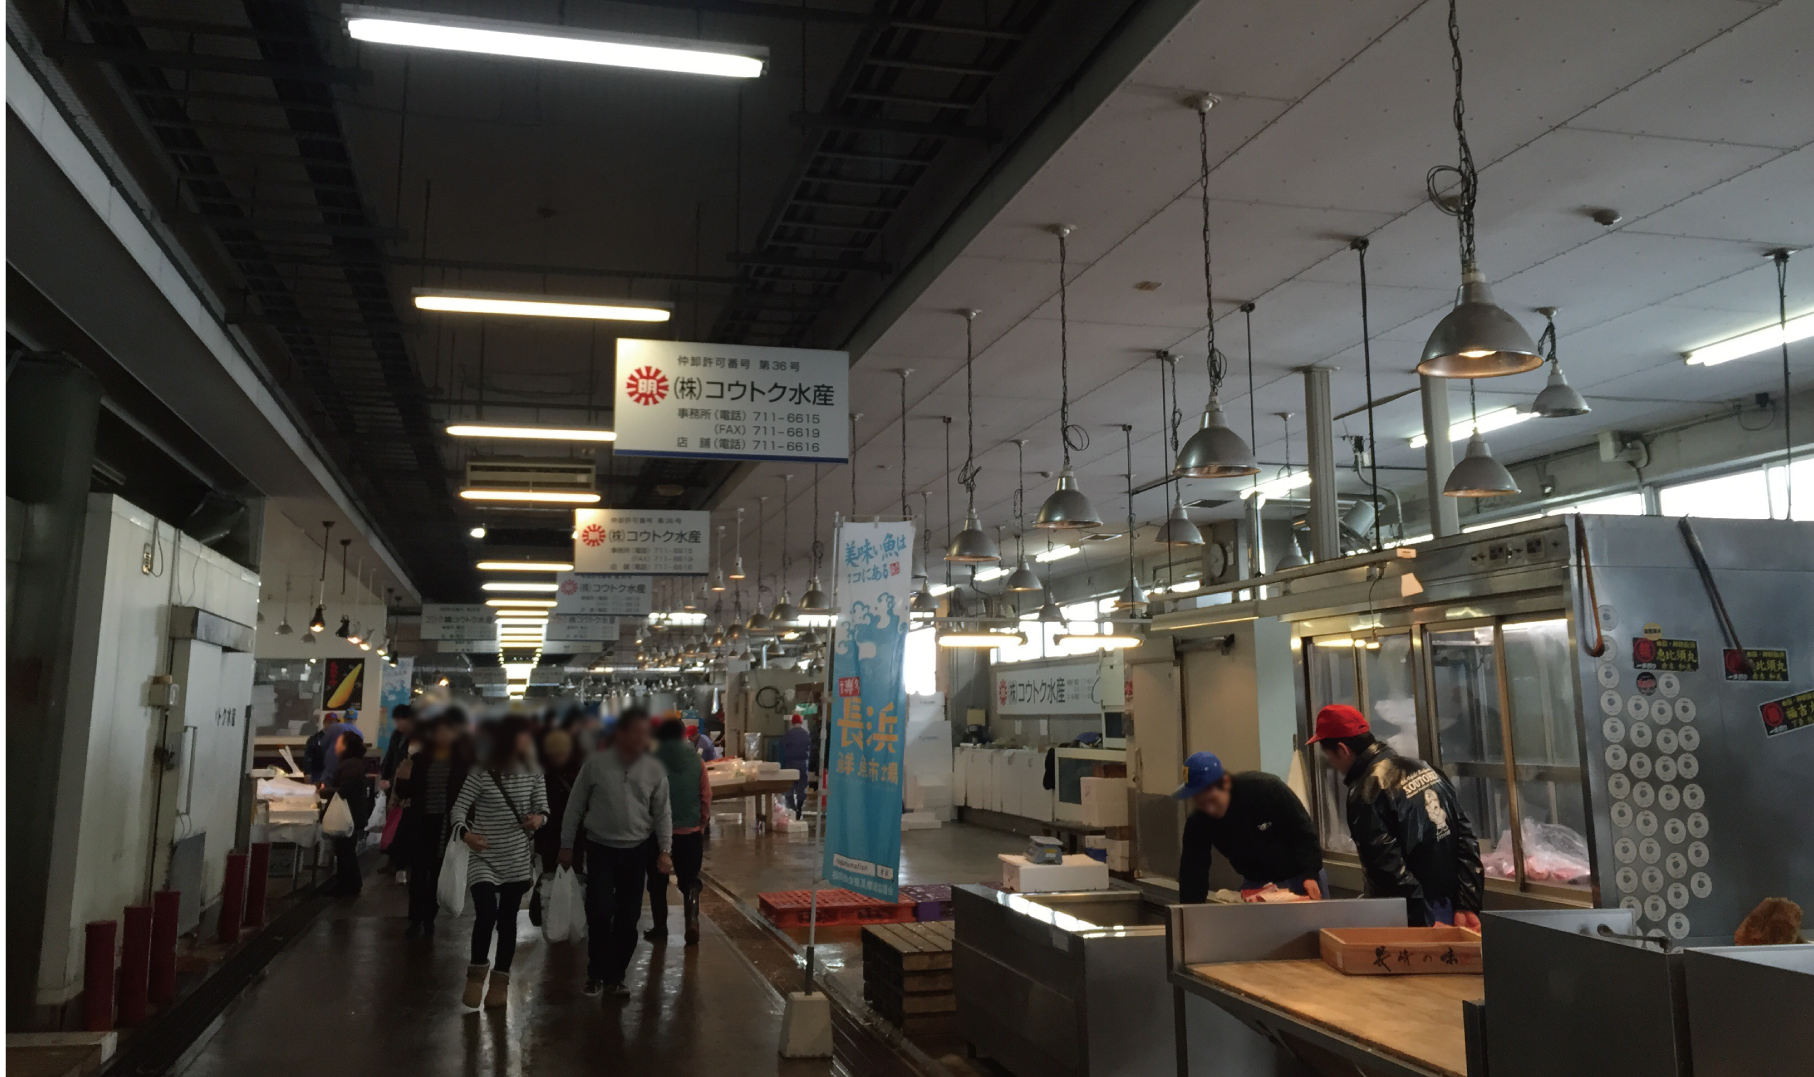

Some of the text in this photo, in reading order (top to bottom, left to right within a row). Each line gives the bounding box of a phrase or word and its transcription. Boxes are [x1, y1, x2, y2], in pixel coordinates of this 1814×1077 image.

[677, 355, 801, 372] 仲卸許可番号 第36号
[638, 378, 657, 394] 明
[673, 376, 835, 407] (株)コウトク水産
[753, 411, 820, 425] 711-6615
[714, 424, 820, 439] (FAX) 711-6619
[752, 440, 820, 453] 711-6616
[608, 530, 702, 543] (株)コウトク水産
[844, 532, 907, 568] 美味い魚は
[837, 696, 899, 754] 長浜
[836, 751, 899, 785] 鮮魚市場
